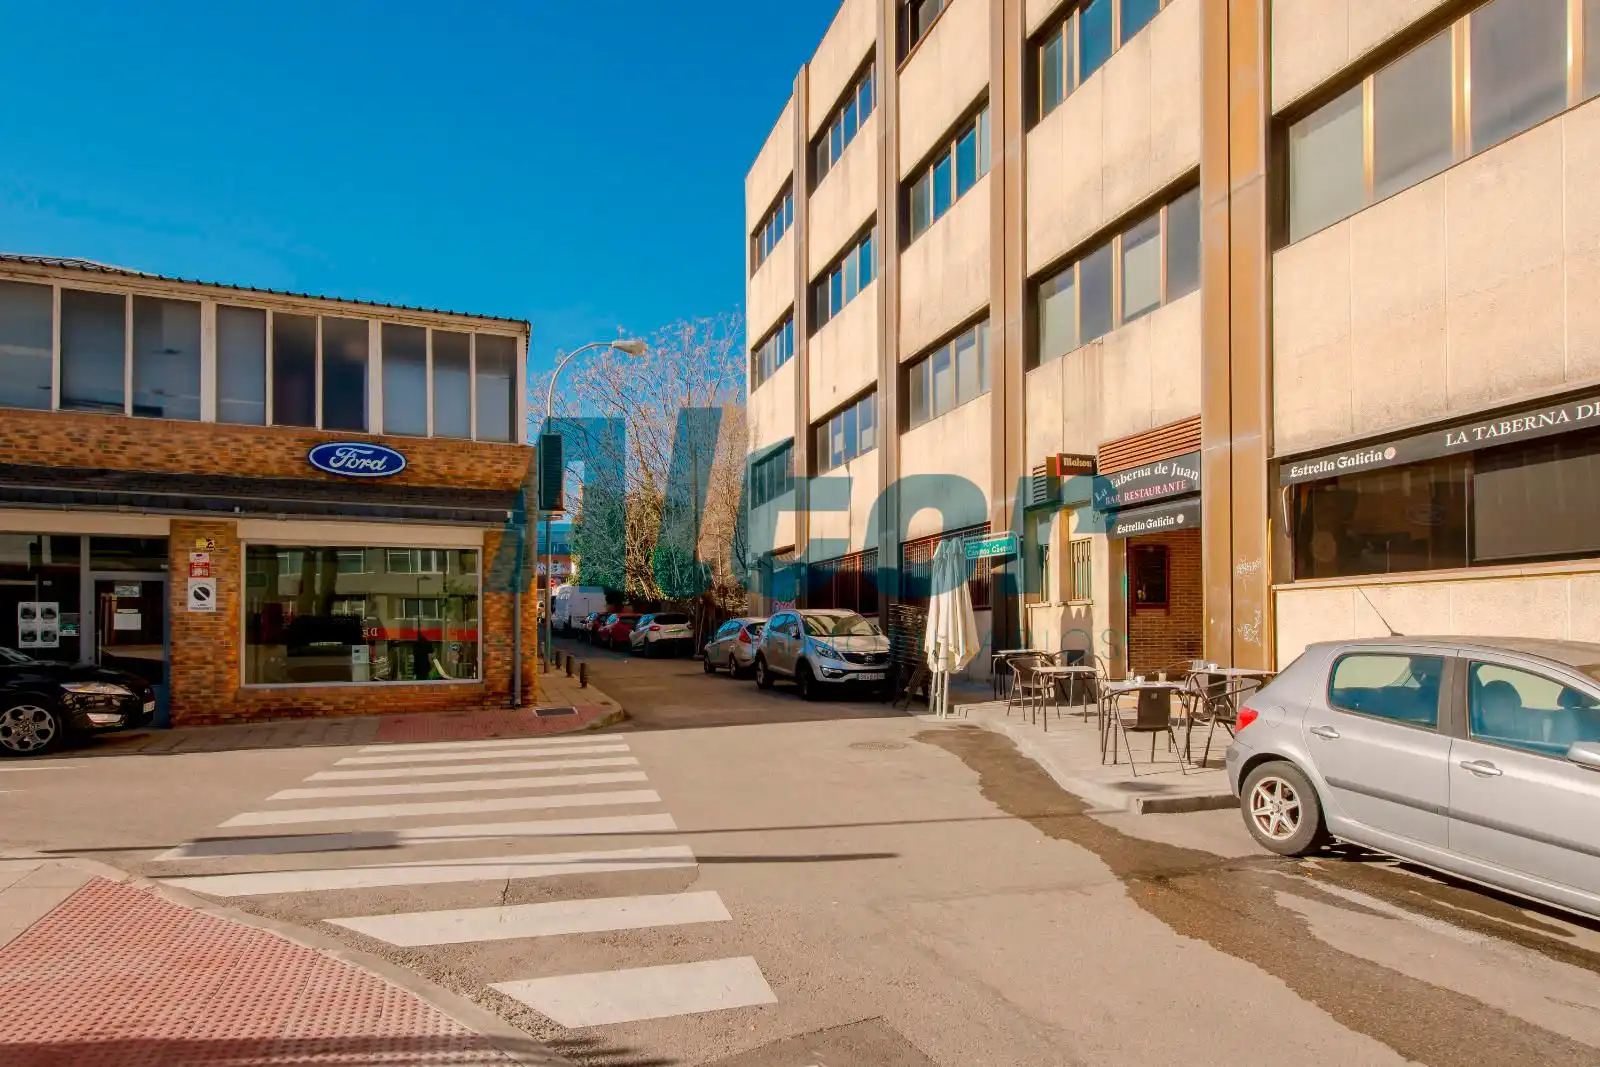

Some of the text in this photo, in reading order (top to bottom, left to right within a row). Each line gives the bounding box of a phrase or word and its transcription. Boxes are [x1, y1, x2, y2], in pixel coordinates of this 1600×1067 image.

[1446, 431, 1469, 447] LA
[1472, 409, 1571, 441] TABERNA
[329, 447, 388, 471] Ford
[1290, 450, 1383, 478] Estrella Galicia
[1095, 462, 1199, 502] La Taberna de Juan
[1105, 479, 1188, 505] BAR RESTAURANTE
[1116, 515, 1175, 534] Estrella Galicia
